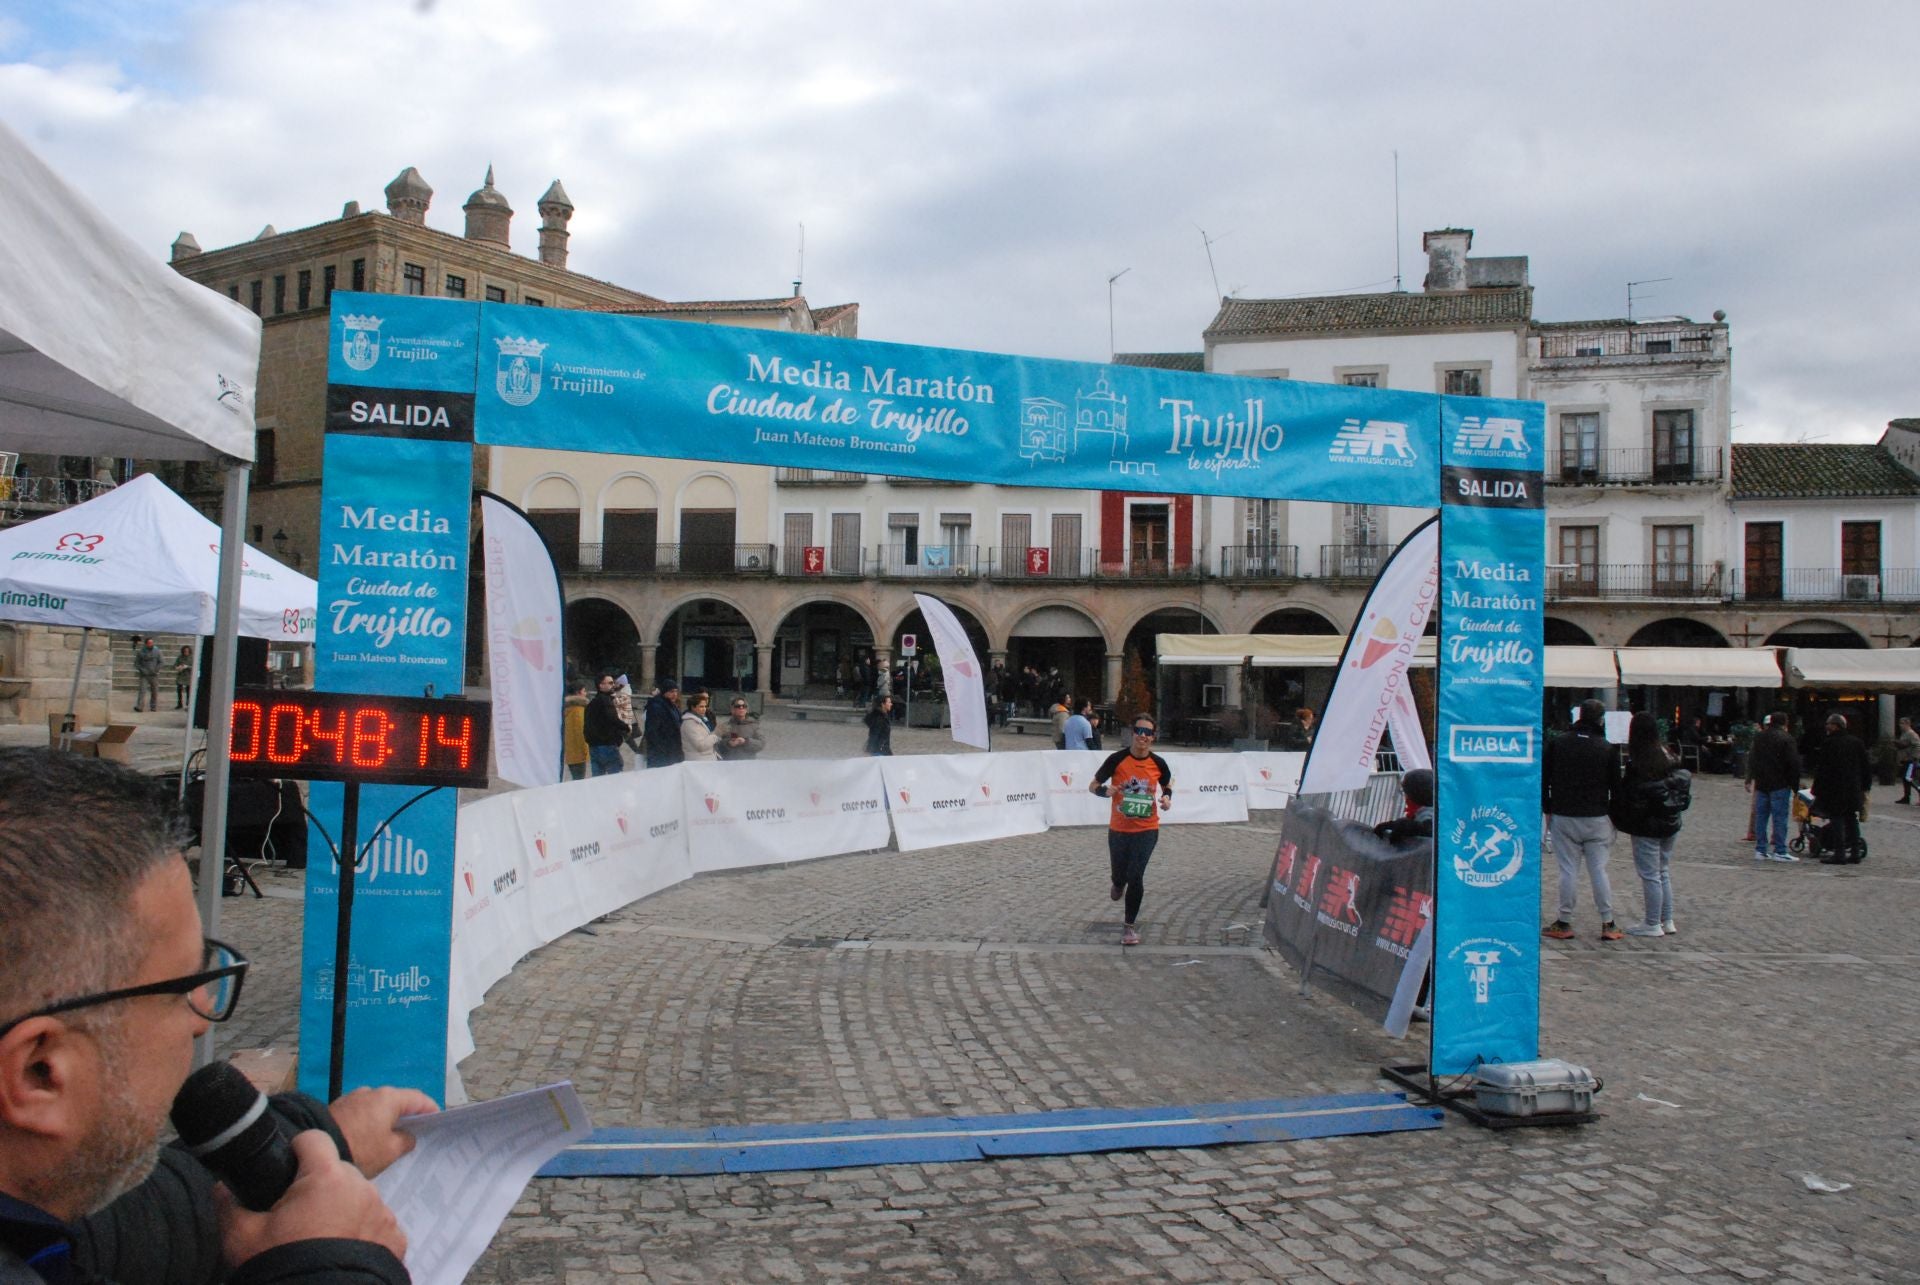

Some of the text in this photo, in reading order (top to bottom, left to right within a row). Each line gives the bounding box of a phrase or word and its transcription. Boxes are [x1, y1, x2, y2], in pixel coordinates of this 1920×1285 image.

[387, 335, 465, 348] Ayuntamiento de
[386, 345, 438, 362] Trujillo
[551, 362, 647, 380] Ayuntamiento de
[746, 354, 995, 404] Media Maratón
[551, 376, 615, 396] Trujillo
[350, 400, 450, 427] SALIDA
[706, 384, 969, 443] Ciudad de Trujillo
[1159, 397, 1284, 462] Trujillo
[753, 428, 917, 455] Juan Mateos Broncano
[1187, 449, 1202, 470] te
[1328, 454, 1414, 467] www.musicrun.es
[1458, 478, 1528, 499] SALIDA
[340, 505, 451, 534] Media
[12, 552, 105, 565] primaflor
[331, 543, 457, 570] Maratón
[1455, 560, 1531, 582] Media
[347, 577, 440, 598] Ciudad de
[0, 590, 68, 610] rimaflor
[1450, 590, 1537, 611] Maratón
[329, 599, 452, 649] Trujillo
[1460, 616, 1523, 634] Ciudad de
[1398, 632, 1417, 657] DE
[1448, 634, 1534, 673] Trujillo
[333, 651, 448, 666] Juan Mateos Broncano
[1460, 736, 1521, 752] HABLA
[1127, 802, 1149, 815] 217
[1451, 805, 1518, 845] Club Atletismo
[368, 965, 431, 993] Trujillo
